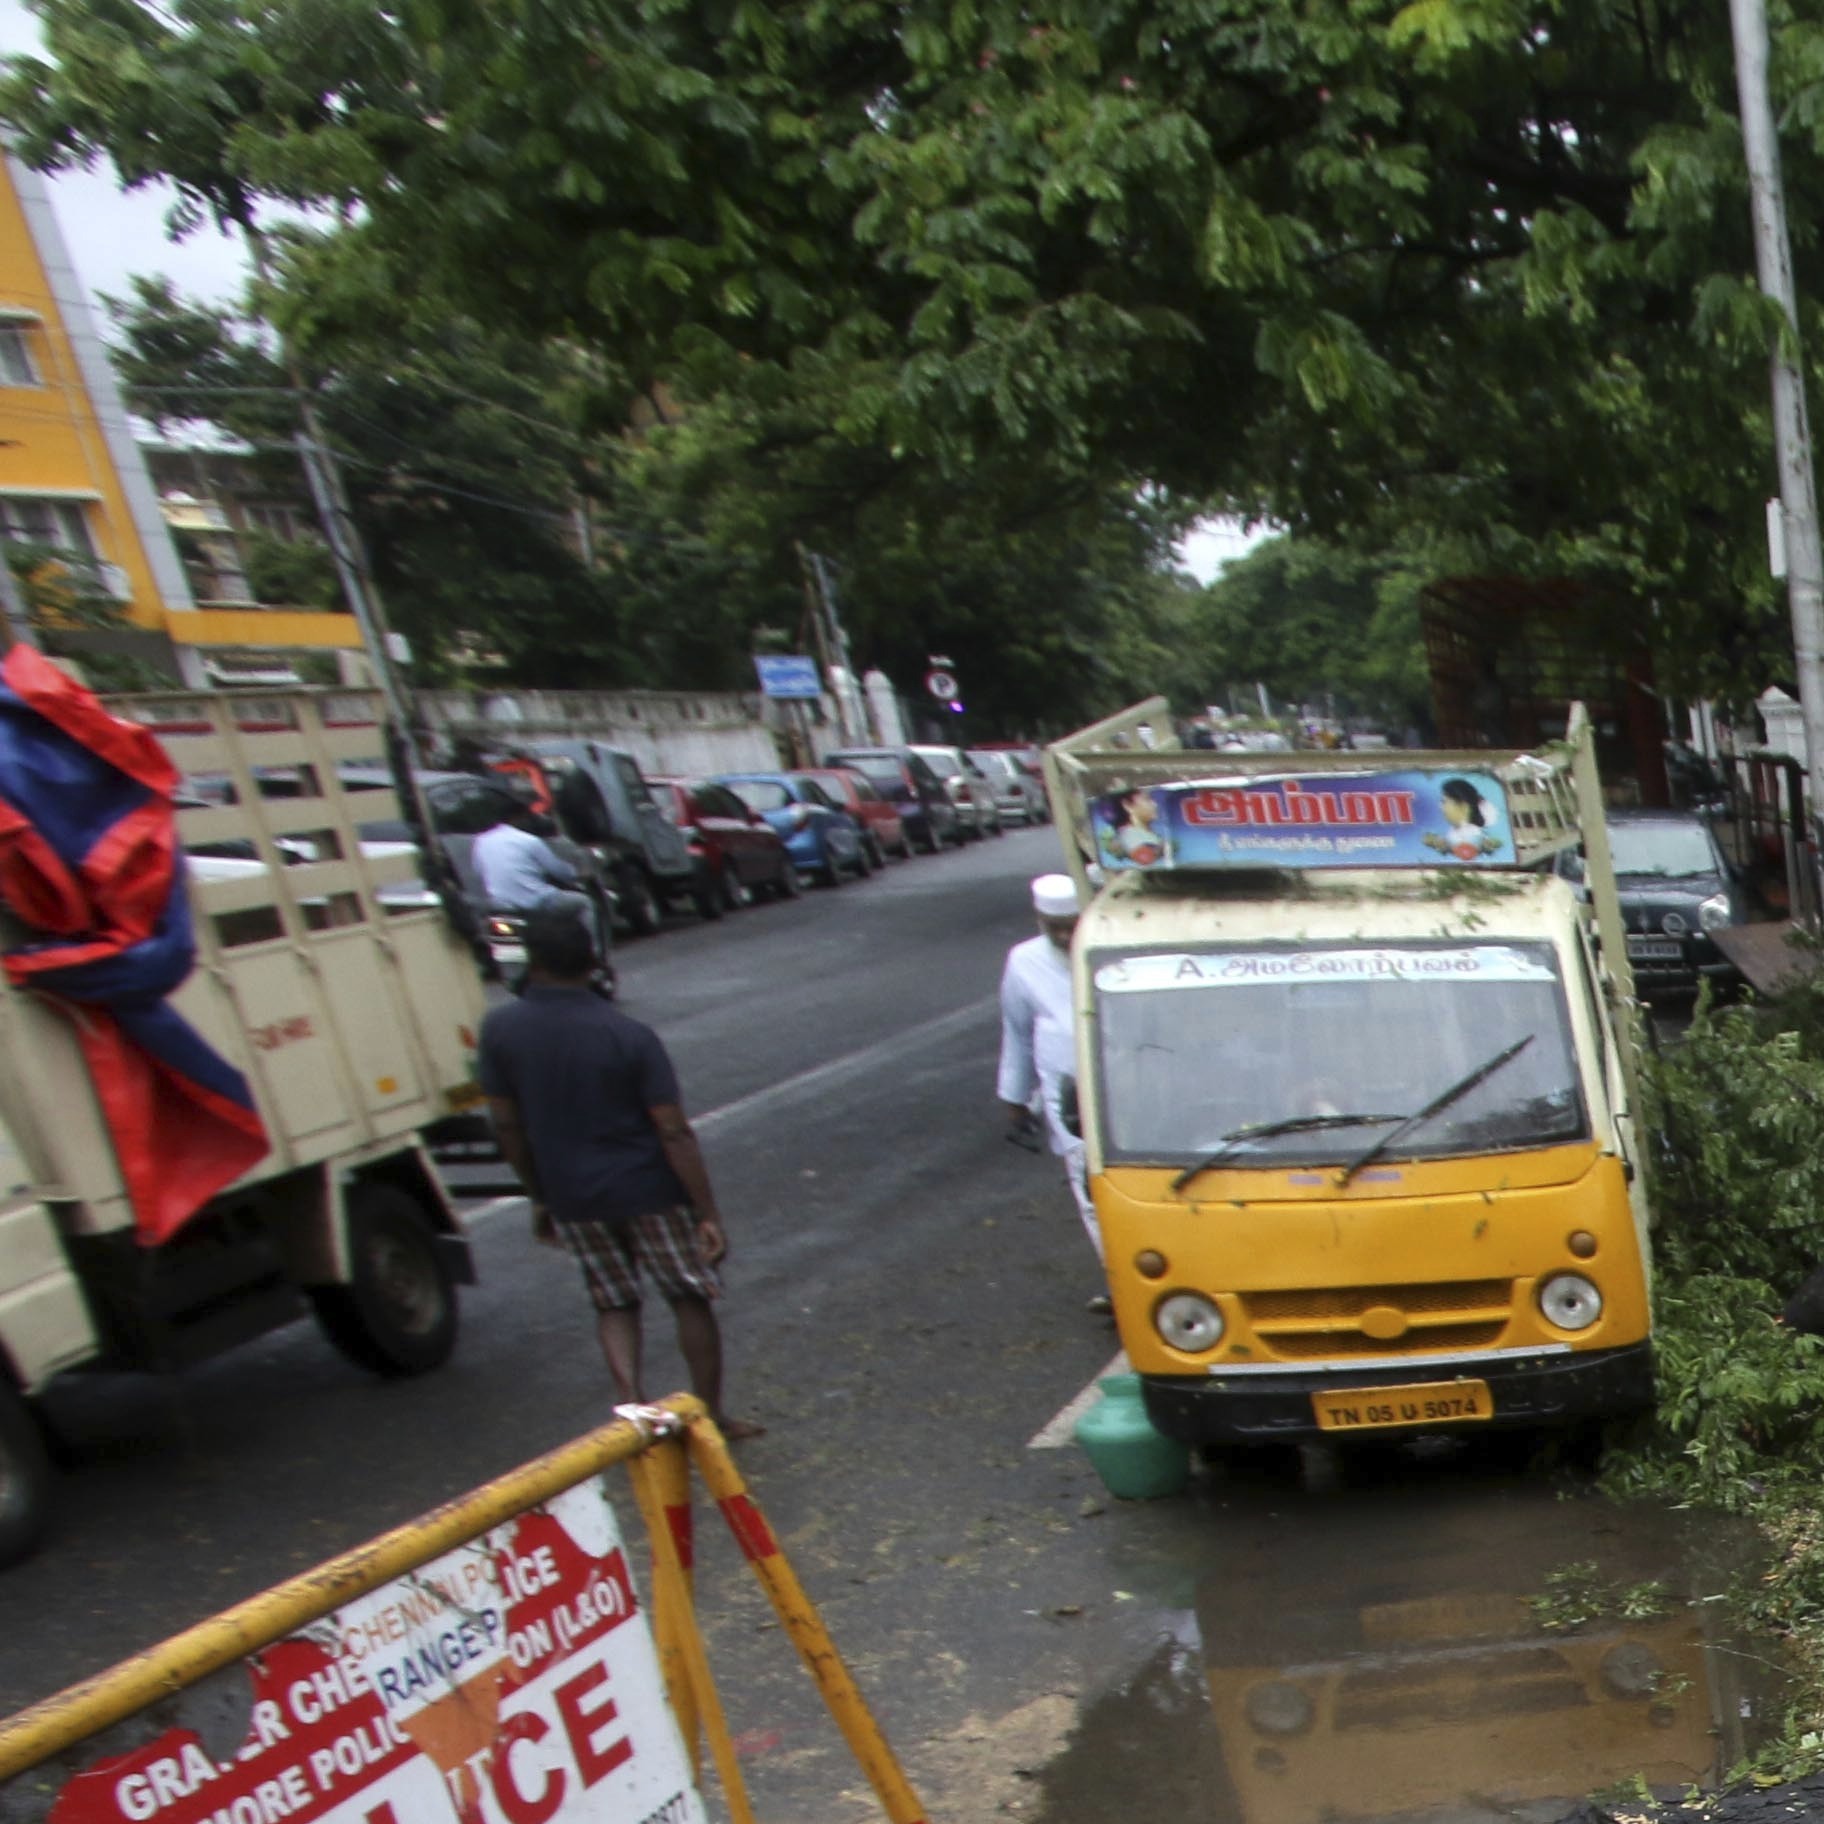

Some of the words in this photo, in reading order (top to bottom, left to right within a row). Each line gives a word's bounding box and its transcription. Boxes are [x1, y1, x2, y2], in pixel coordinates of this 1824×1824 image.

[1182, 780, 1415, 826] அம்மா
[1327, 1408, 1360, 1426] TN
[1367, 1405, 1393, 1423] 05
[1423, 1398, 1478, 1419] 5074
[309, 1711, 412, 1792] POLIC
